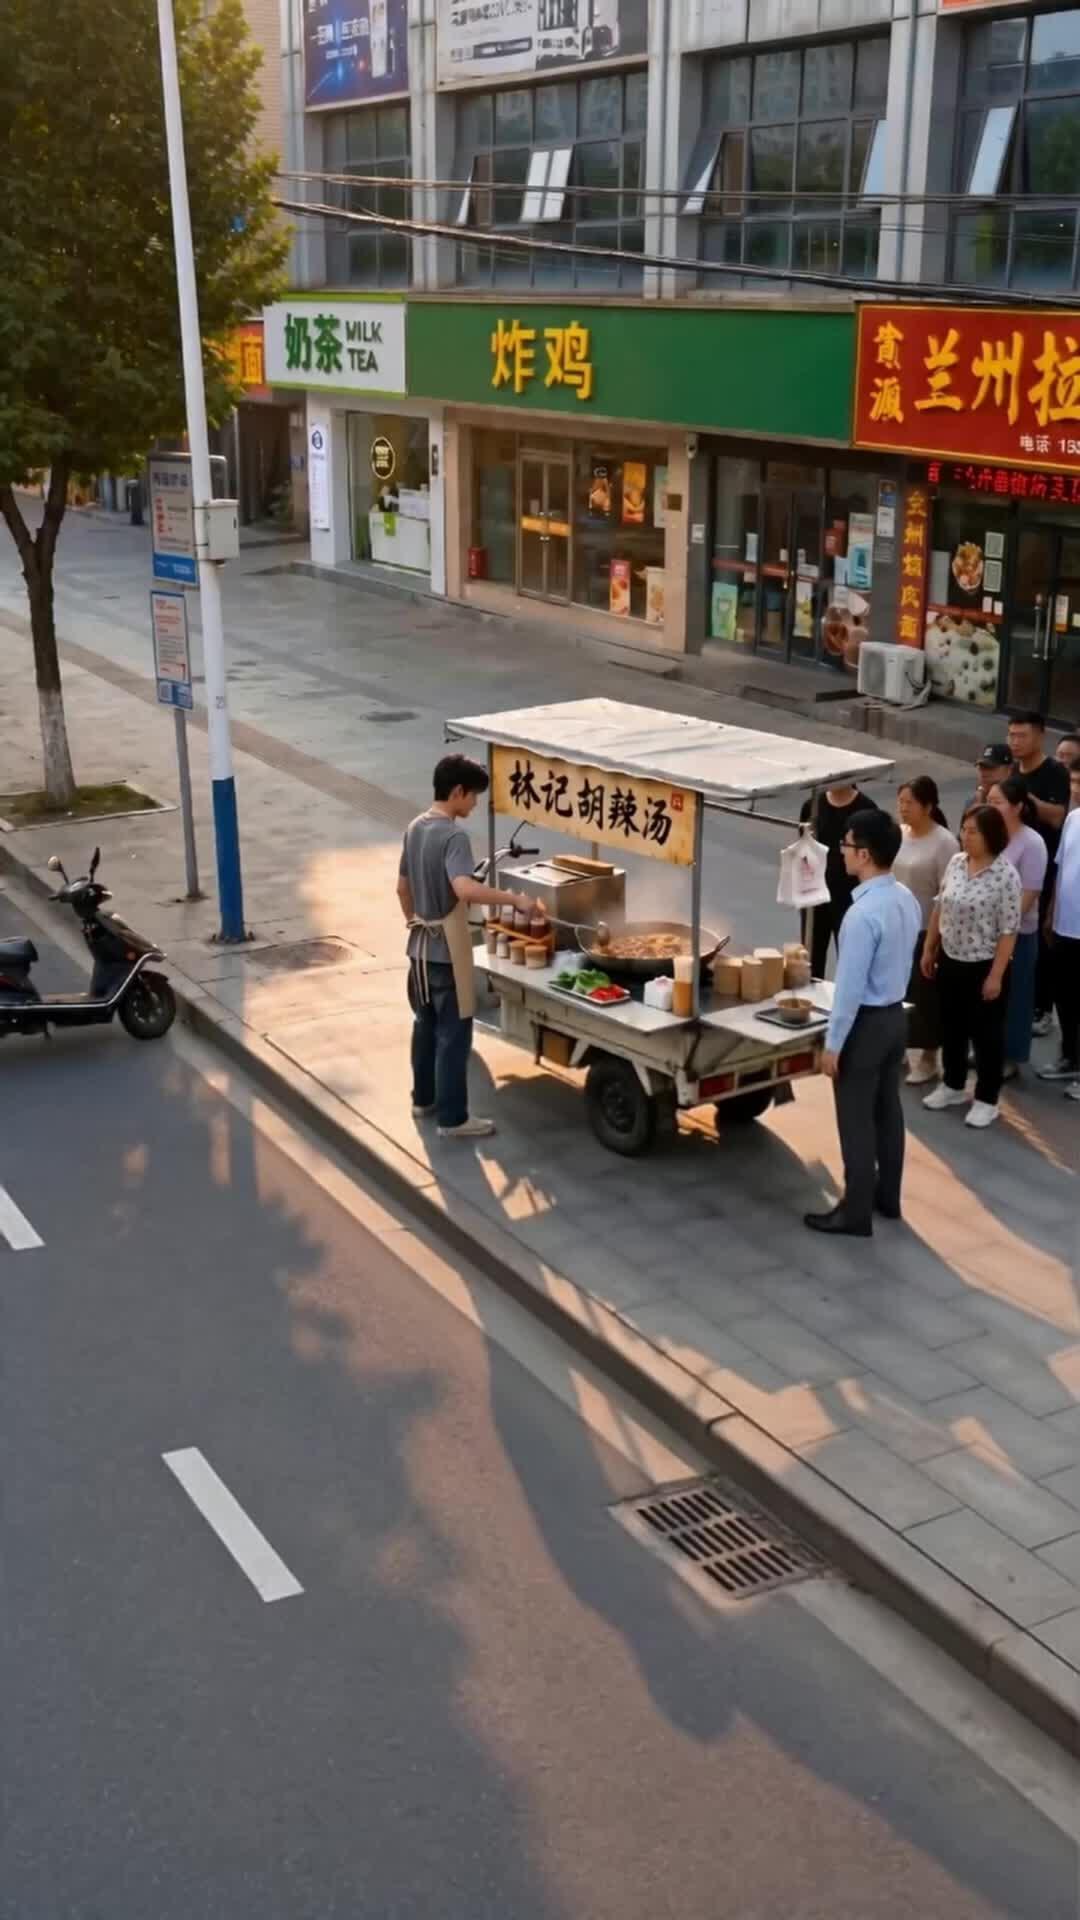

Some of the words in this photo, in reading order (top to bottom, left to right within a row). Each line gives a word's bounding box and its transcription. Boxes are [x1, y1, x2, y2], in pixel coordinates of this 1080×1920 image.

[284, 313, 342, 373] 奶茶
[346, 320, 382, 343] MILK
[348, 348, 378, 373] TEA
[490, 318, 592, 398] 炸鸡
[1020, 434, 1050, 453] 电话
[509, 760, 673, 845] 林记胡辣汤
